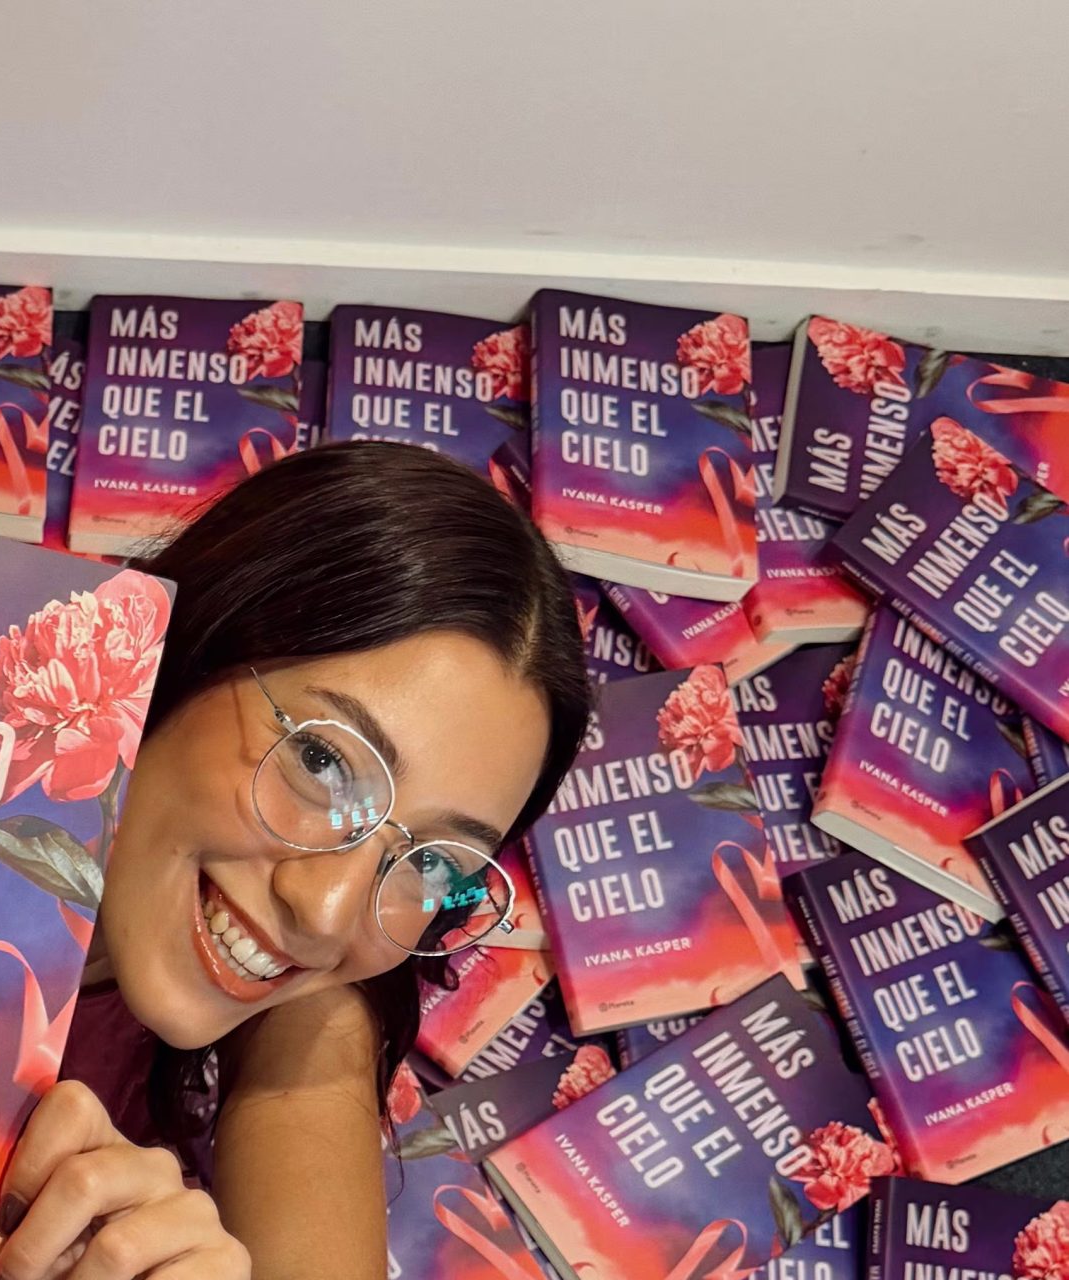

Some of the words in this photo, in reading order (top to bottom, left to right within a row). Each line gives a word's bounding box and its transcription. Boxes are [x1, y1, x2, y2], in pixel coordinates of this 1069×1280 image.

[111, 304, 177, 338] MÁS
[561, 306, 625, 345] MÁS
[107, 345, 248, 384] INMENSO
[562, 347, 699, 398] INMENSO
[103, 385, 161, 419] QUE
[174, 390, 208, 421] EL
[561, 389, 618, 428] QUE
[632, 400, 666, 436] EL
[99, 424, 187, 461] CIELO
[562, 430, 648, 476] CIELO
[554, 819, 622, 872] QUE
[629, 810, 673, 854] EL
[568, 867, 665, 922] CIELO
[829, 869, 896, 923] MÁS
[874, 974, 936, 1032] QUE
[933, 960, 976, 1005] EL
[742, 1002, 815, 1078] MÁS
[896, 1016, 982, 1081] CIELO
[644, 1064, 715, 1133] QUE
[692, 1126, 742, 1176] EL
[694, 1032, 820, 1173] INMENSO
[597, 1094, 685, 1189] CIELO
[553, 1132, 594, 1178] IVANA
[586, 1175, 633, 1229] KASPER
[907, 1201, 968, 1252] MÁS
